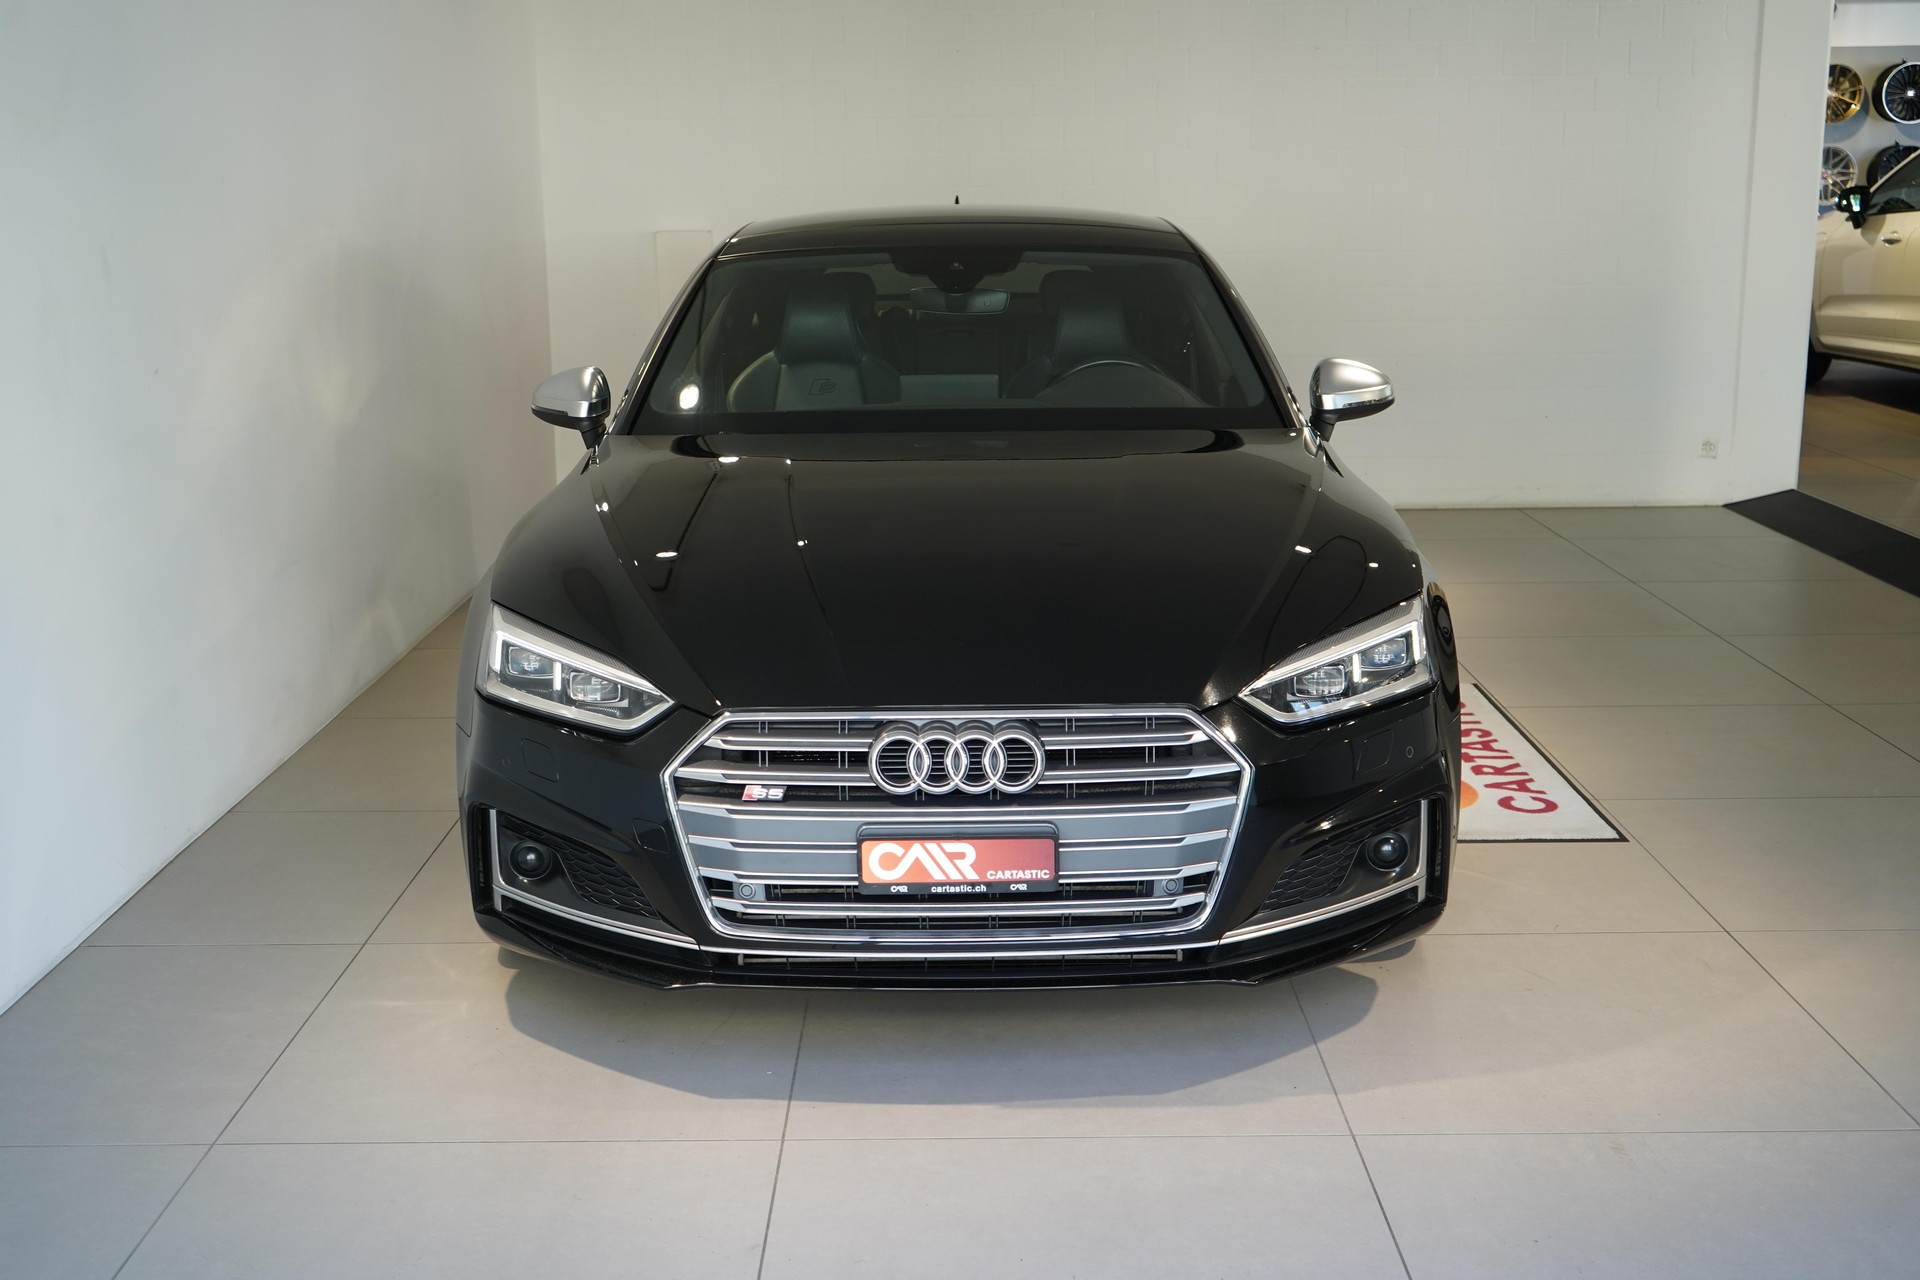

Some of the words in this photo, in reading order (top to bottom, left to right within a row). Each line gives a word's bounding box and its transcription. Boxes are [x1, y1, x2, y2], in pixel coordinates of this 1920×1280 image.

[1460, 701, 1559, 814] CARTAS
[986, 869, 1050, 880] CARTASTIC
[931, 884, 987, 893] cartastic.ch
